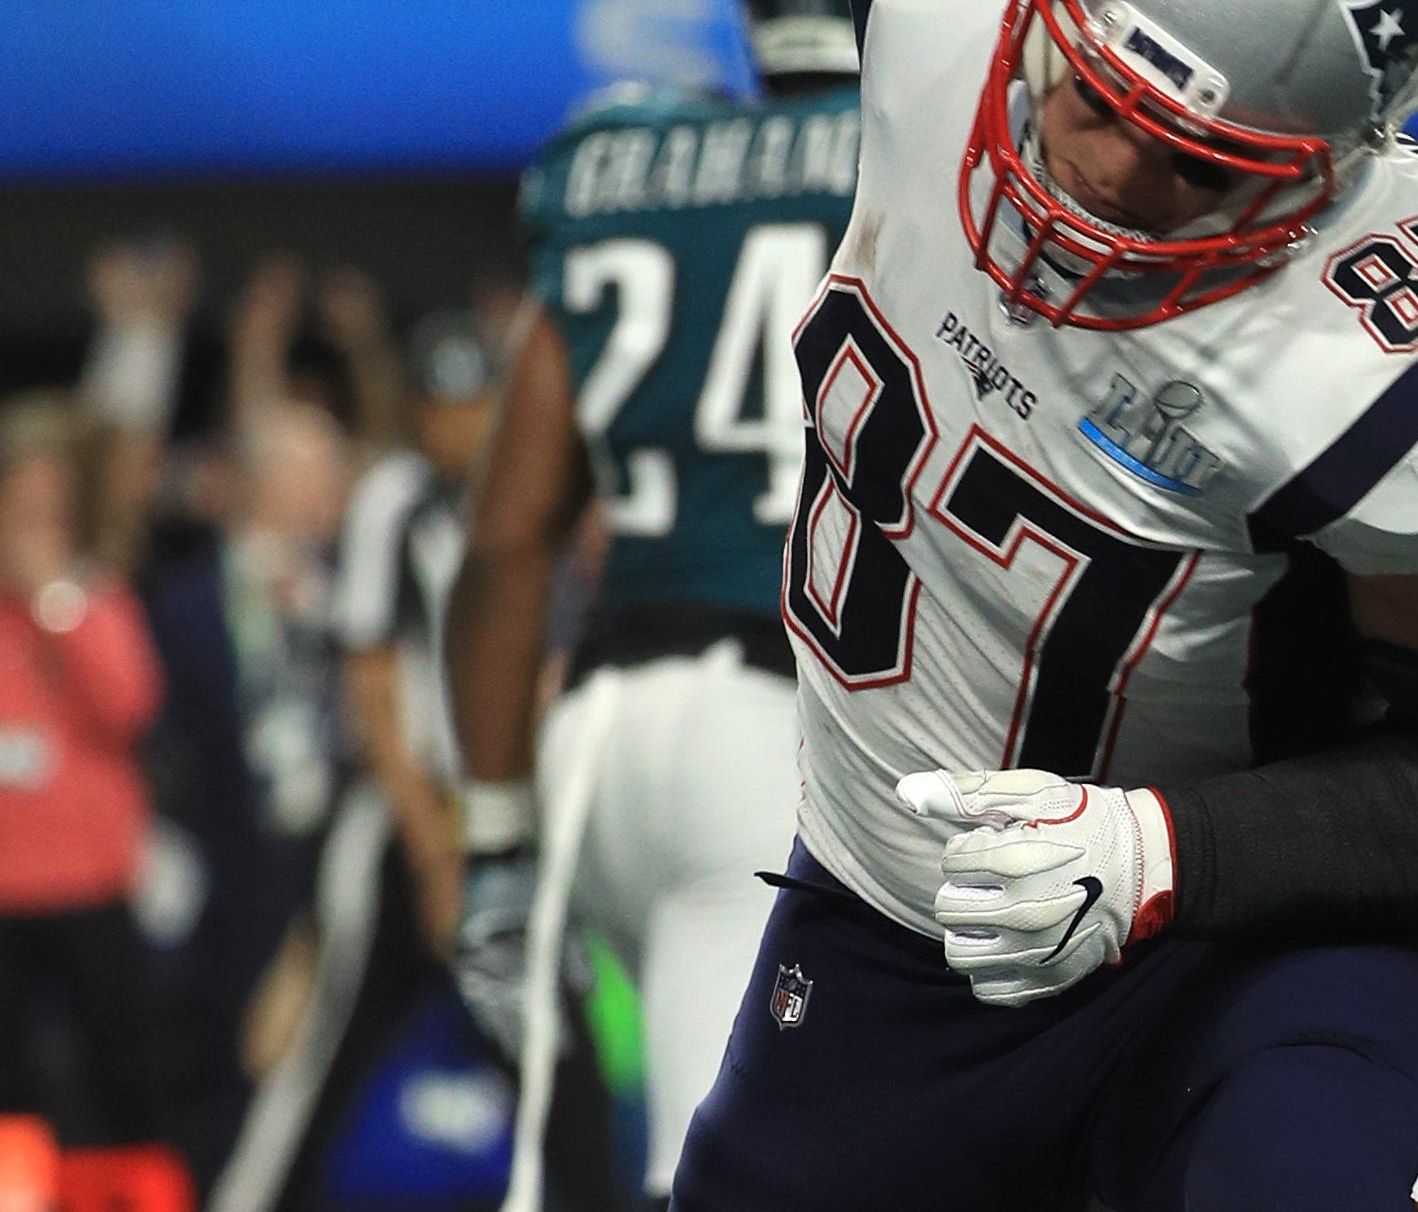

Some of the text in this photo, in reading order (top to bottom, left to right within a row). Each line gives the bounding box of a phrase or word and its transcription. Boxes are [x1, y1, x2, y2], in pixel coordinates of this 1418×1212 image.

[563, 222, 828, 539] 24
[936, 311, 1038, 421] PATRIOTS
[780, 274, 1205, 786] 87
